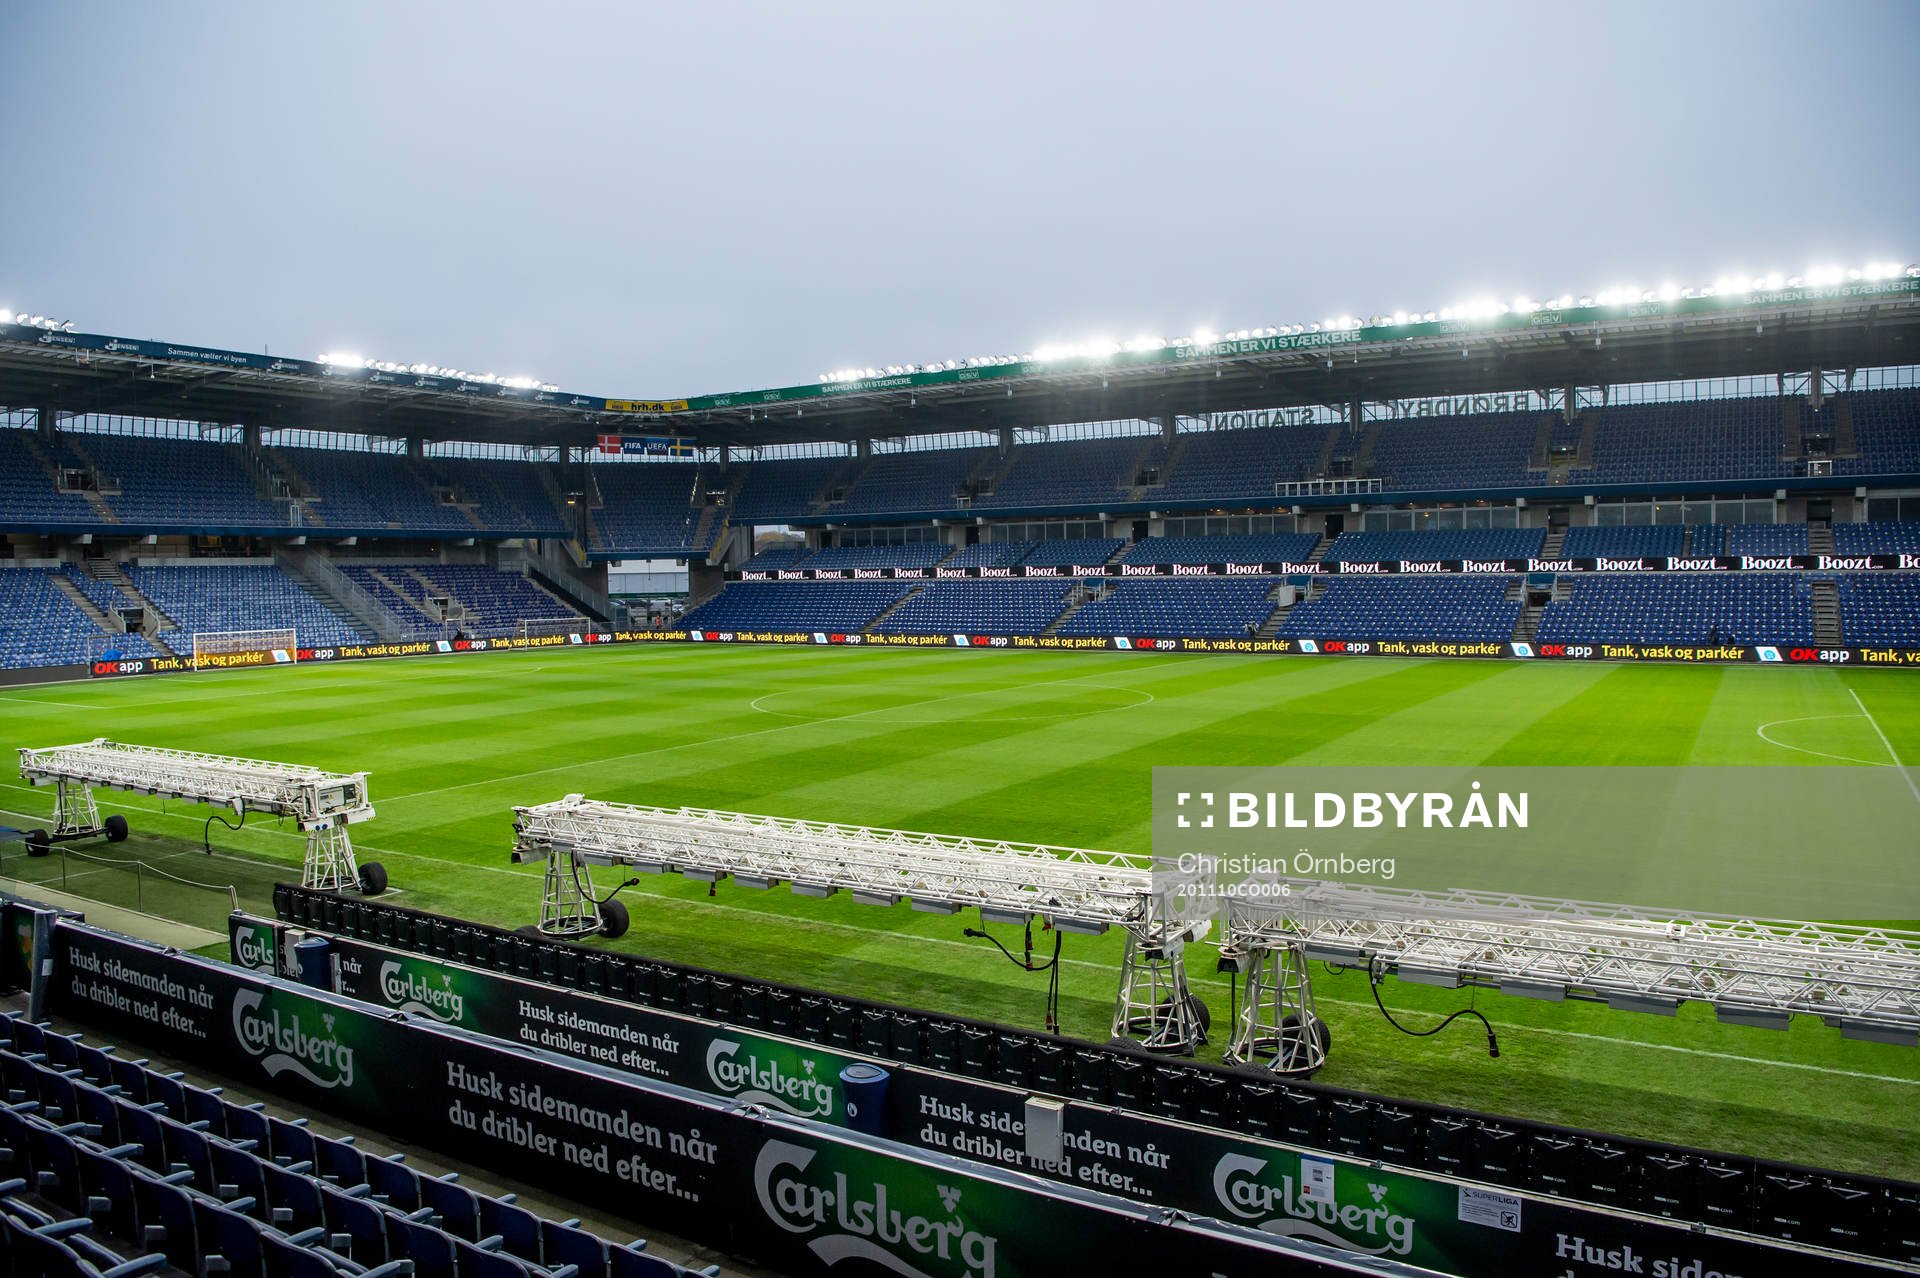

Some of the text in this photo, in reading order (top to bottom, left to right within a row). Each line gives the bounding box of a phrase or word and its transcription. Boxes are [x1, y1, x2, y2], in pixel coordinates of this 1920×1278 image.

[167, 347, 199, 358] Sammen
[1175, 330, 1362, 359] SAMMEN ER VI STÆRKERE
[631, 402, 665, 411] hrh.dk
[491, 638, 512, 648] Tank,
[514, 638, 530, 646] vask
[531, 638, 541, 647] og
[541, 634, 565, 646] parkér
[615, 631, 632, 641] Tank,
[633, 630, 652, 640] vask
[653, 631, 664, 641] og
[665, 629, 686, 641] parkér
[737, 631, 756, 642] Tank,
[757, 632, 772, 641] vask
[773, 633, 784, 643] og
[784, 631, 808, 643] parkér
[866, 634, 888, 644] Tank,
[889, 634, 906, 643] vask
[907, 635, 919, 645] og
[919, 634, 947, 645] parkér
[1014, 636, 1038, 647] Tank,
[1039, 636, 1059, 647] vask
[1061, 638, 1073, 648] og
[1075, 636, 1107, 648] parkér
[1183, 639, 1211, 651] Tank,
[1213, 639, 1236, 650] vask
[1237, 640, 1251, 652] og
[1254, 639, 1290, 652] parkér
[340, 646, 366, 658] Tank,
[367, 645, 387, 656] vask
[388, 645, 401, 655] og
[402, 642, 430, 654] parkér
[1377, 641, 1409, 655] Tank,
[1412, 641, 1439, 654] vask
[1441, 643, 1456, 656] og
[1459, 642, 1501, 656] parkér
[1602, 645, 1639, 659] Tank,
[1641, 645, 1673, 659] vask
[1675, 648, 1693, 661] og
[1696, 645, 1745, 660] parkér
[1860, 649, 1903, 663] Tank,
[151, 657, 184, 671] Tank,
[186, 655, 211, 668] vask
[212, 654, 227, 667] og
[229, 651, 264, 666] parkér
[343, 957, 362, 974] når
[69, 946, 214, 1010] Husk sidemanden når
[380, 961, 463, 1022] Carlsberg
[72, 974, 207, 1038] du dribler ned efter...
[233, 988, 354, 1089] Carlsberg
[519, 1000, 679, 1054] Husk sidemanden når
[520, 1024, 669, 1077] du dribler ned efter...
[706, 1038, 833, 1117] Carlsberg
[447, 1061, 717, 1165] Husk sidemanden når
[919, 1094, 1171, 1170] Husk sidenden når
[449, 1100, 699, 1202] du dribler ned efter...
[920, 1124, 1153, 1197] du dribler ned efter...
[754, 1139, 998, 1278] Carlsberg
[1213, 1152, 1416, 1255] Carlsberg
[1472, 1191, 1519, 1206] SUPERLIGA
[1555, 1233, 1644, 1274] Husk
